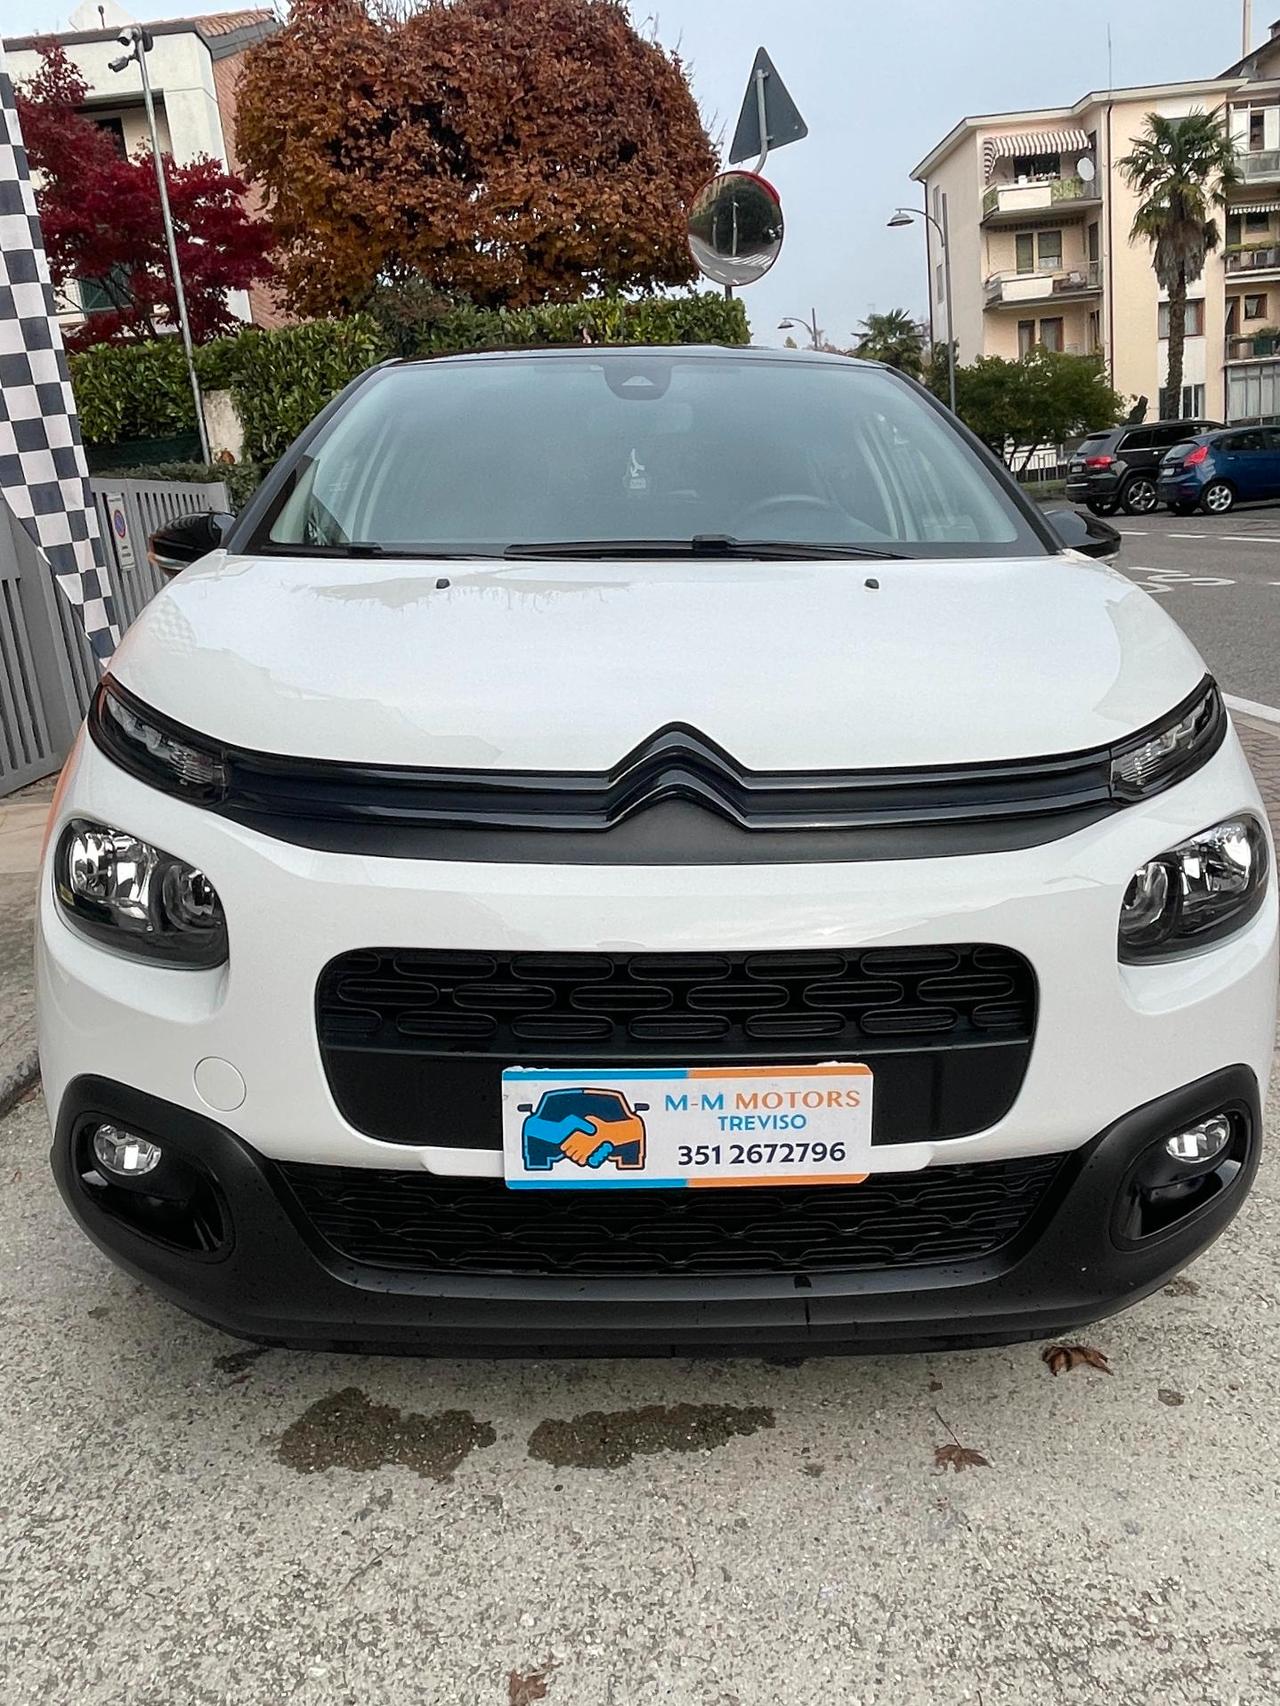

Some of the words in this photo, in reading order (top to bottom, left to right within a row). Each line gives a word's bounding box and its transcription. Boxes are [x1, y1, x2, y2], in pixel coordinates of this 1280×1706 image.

[665, 1093, 725, 1111] M-M
[735, 1090, 861, 1110] MOTORS
[717, 1113, 808, 1132] TREVISO
[678, 1145, 721, 1166] 351
[729, 1142, 847, 1165] 2672796
